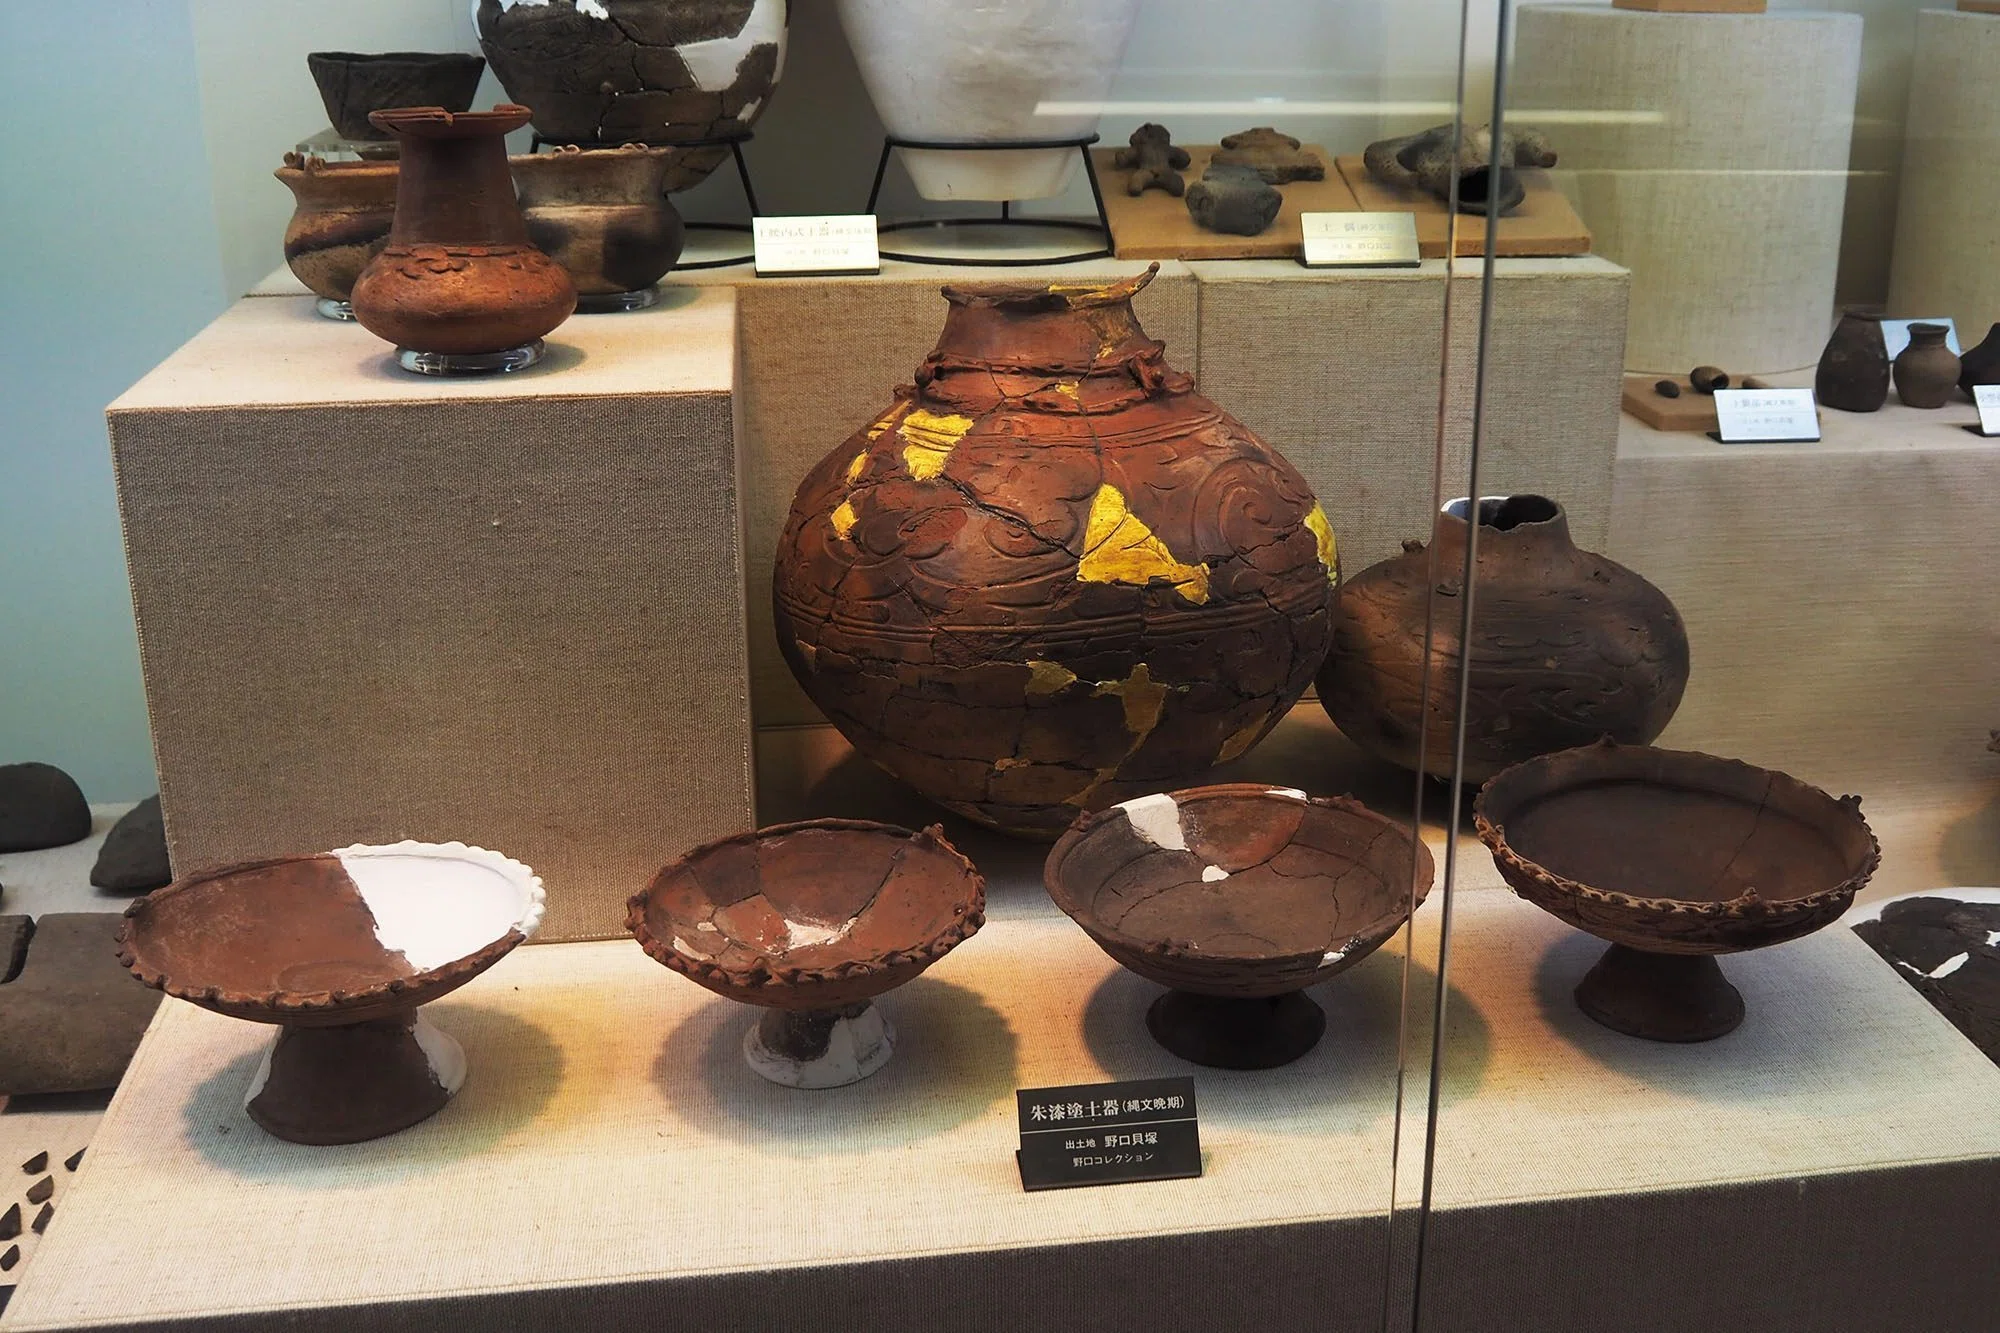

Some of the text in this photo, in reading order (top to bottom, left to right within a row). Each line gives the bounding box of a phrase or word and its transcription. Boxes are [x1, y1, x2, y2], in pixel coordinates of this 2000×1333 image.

[1065, 1131, 1158, 1150] 出土地 野口貝塚
[1072, 1151, 1154, 1167] 野口コレクション
